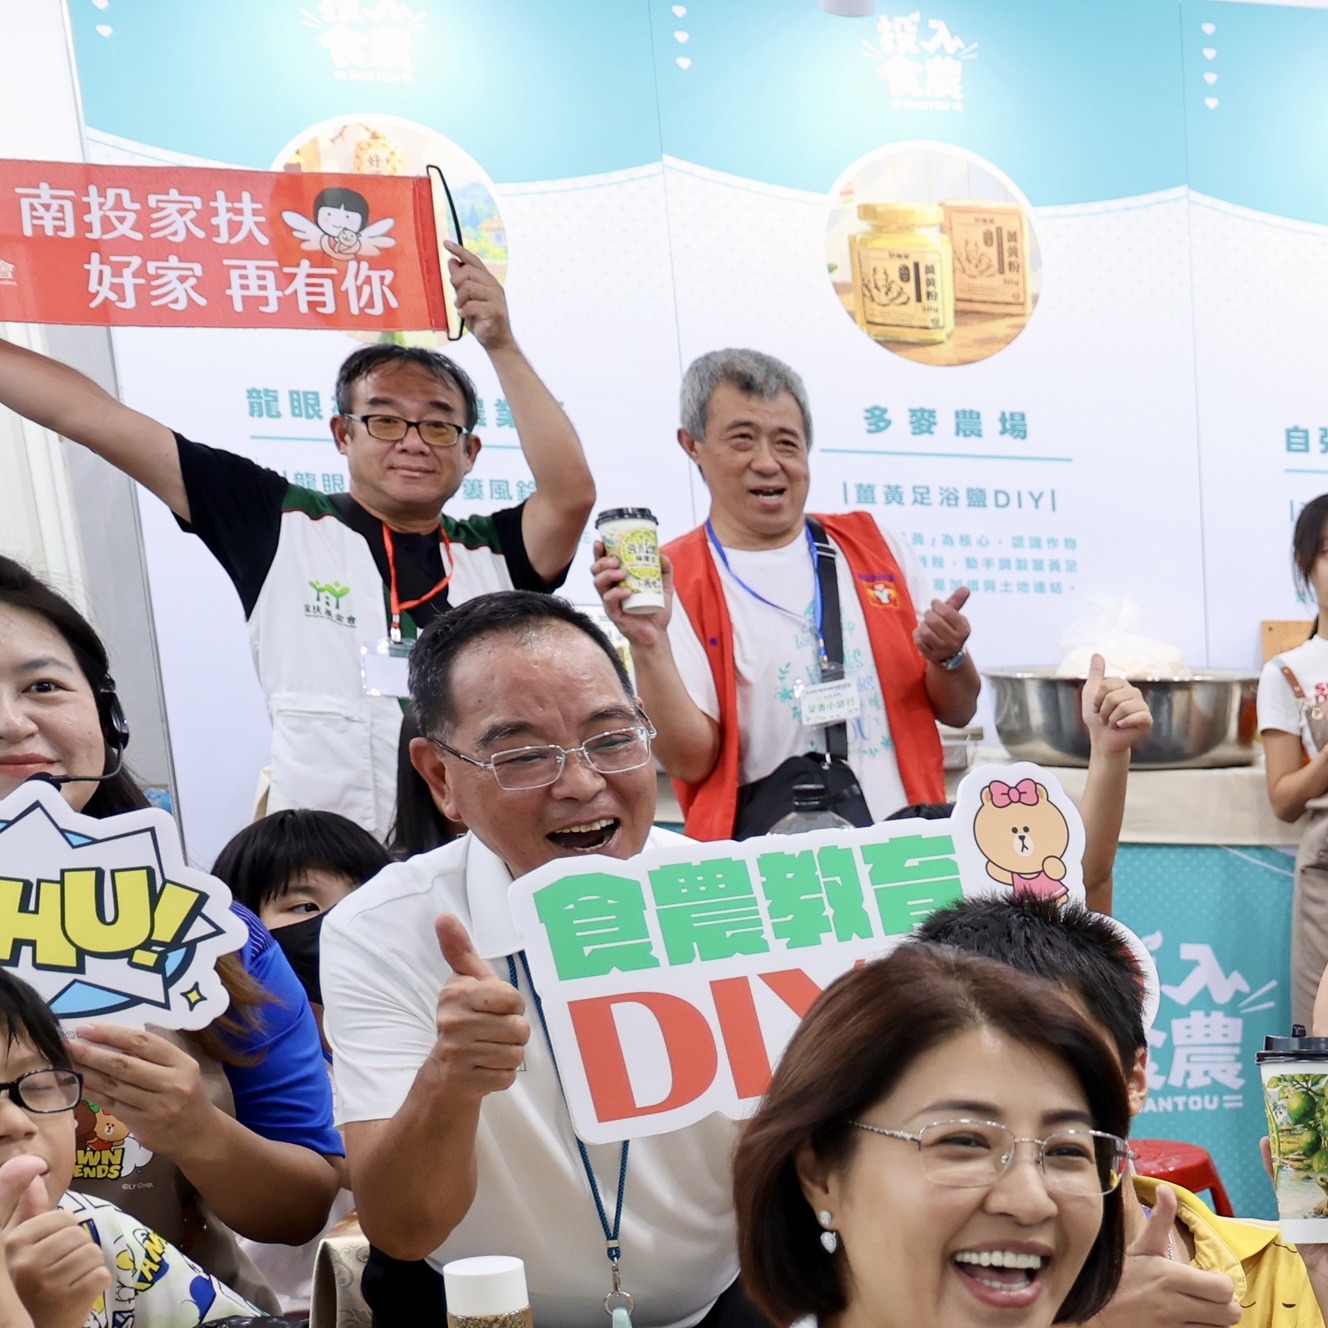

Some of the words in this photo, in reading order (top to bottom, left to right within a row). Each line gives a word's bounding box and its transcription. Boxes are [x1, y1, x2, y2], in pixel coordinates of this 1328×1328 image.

[14, 181, 270, 246] 南投家扶
[83, 251, 208, 310] 好家
[222, 258, 399, 317] 再有你
[532, 834, 965, 981] 食農教育
